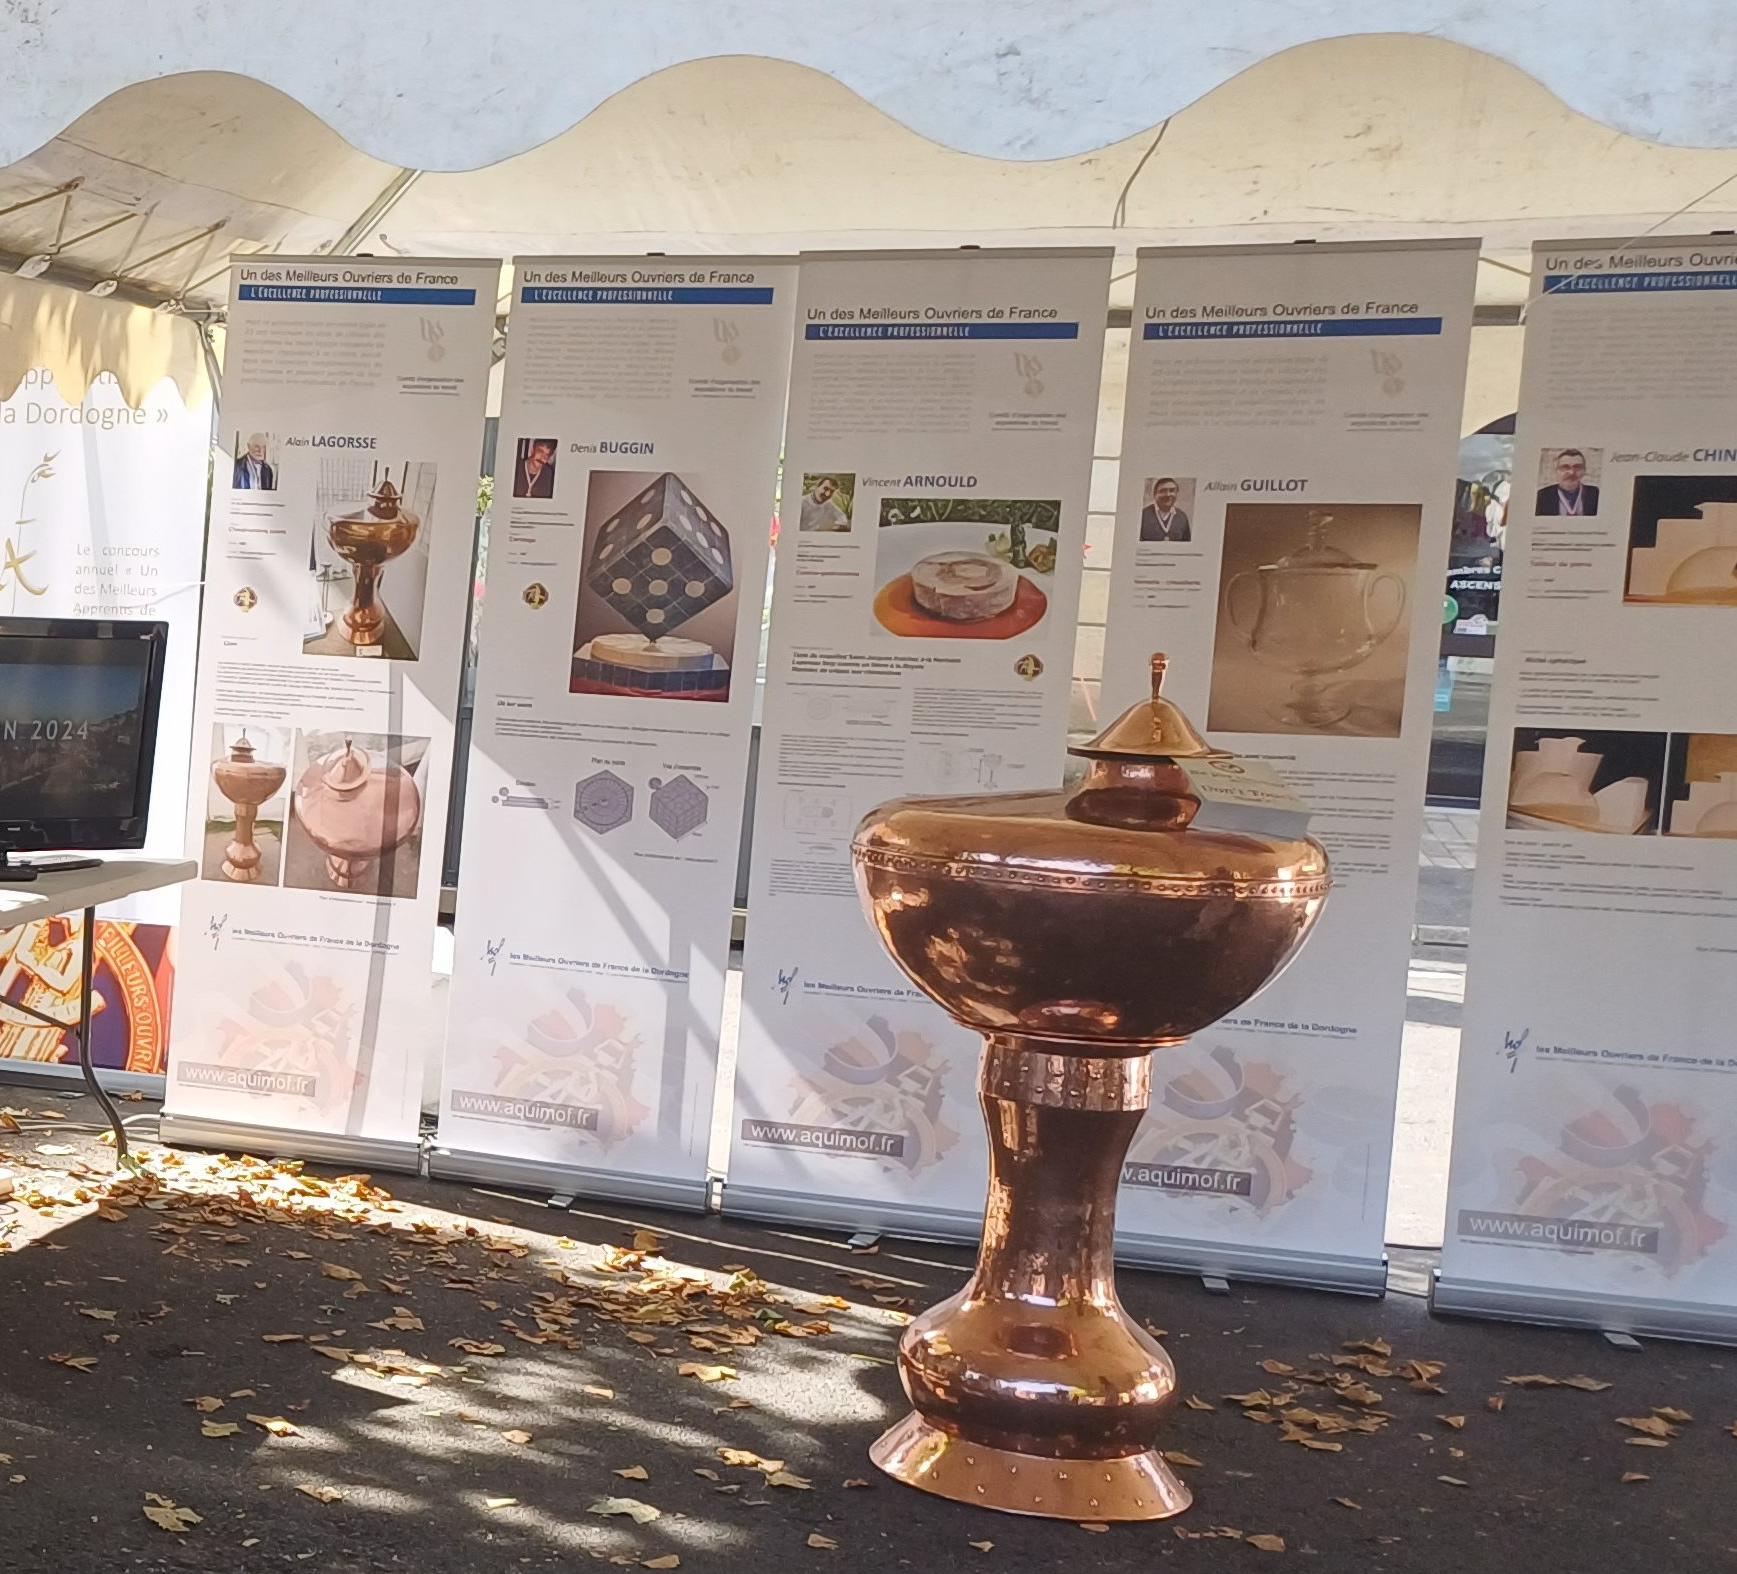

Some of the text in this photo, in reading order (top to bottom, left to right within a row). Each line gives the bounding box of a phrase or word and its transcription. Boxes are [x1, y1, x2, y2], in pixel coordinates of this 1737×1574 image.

[1546, 257, 1568, 271] Un
[1573, 256, 1603, 270] des
[1609, 255, 1683, 269] Meilleurs
[240, 269, 458, 285] Un des Meilleurs Ouvriers de France
[524, 271, 754, 284] Un des Meilleurs Ouvriers de France
[807, 306, 1058, 320] Un des Meilleurs Ouvriers de France
[1145, 301, 1419, 319] Un des Meilleurs Ouvriers de France
[26, 402, 146, 430] Dordogne
[285, 436, 377, 449] Alain LAGORSSE
[570, 442, 654, 455] Denis BUGGIN
[1610, 452, 1690, 463] Jean-Claude
[862, 475, 977, 488] Vincent ARNOULD
[1240, 479, 1308, 492] GUILLOT
[31, 720, 88, 740] 2024
[185, 1065, 309, 1094] www.aquimof.fr
[459, 1094, 590, 1126] www.aquimof.fr
[750, 1123, 895, 1153] www.aquimof.fr
[1122, 1165, 1241, 1191] w.aquimof.fr
[1469, 1216, 1646, 1248] www.aquimof.fr
